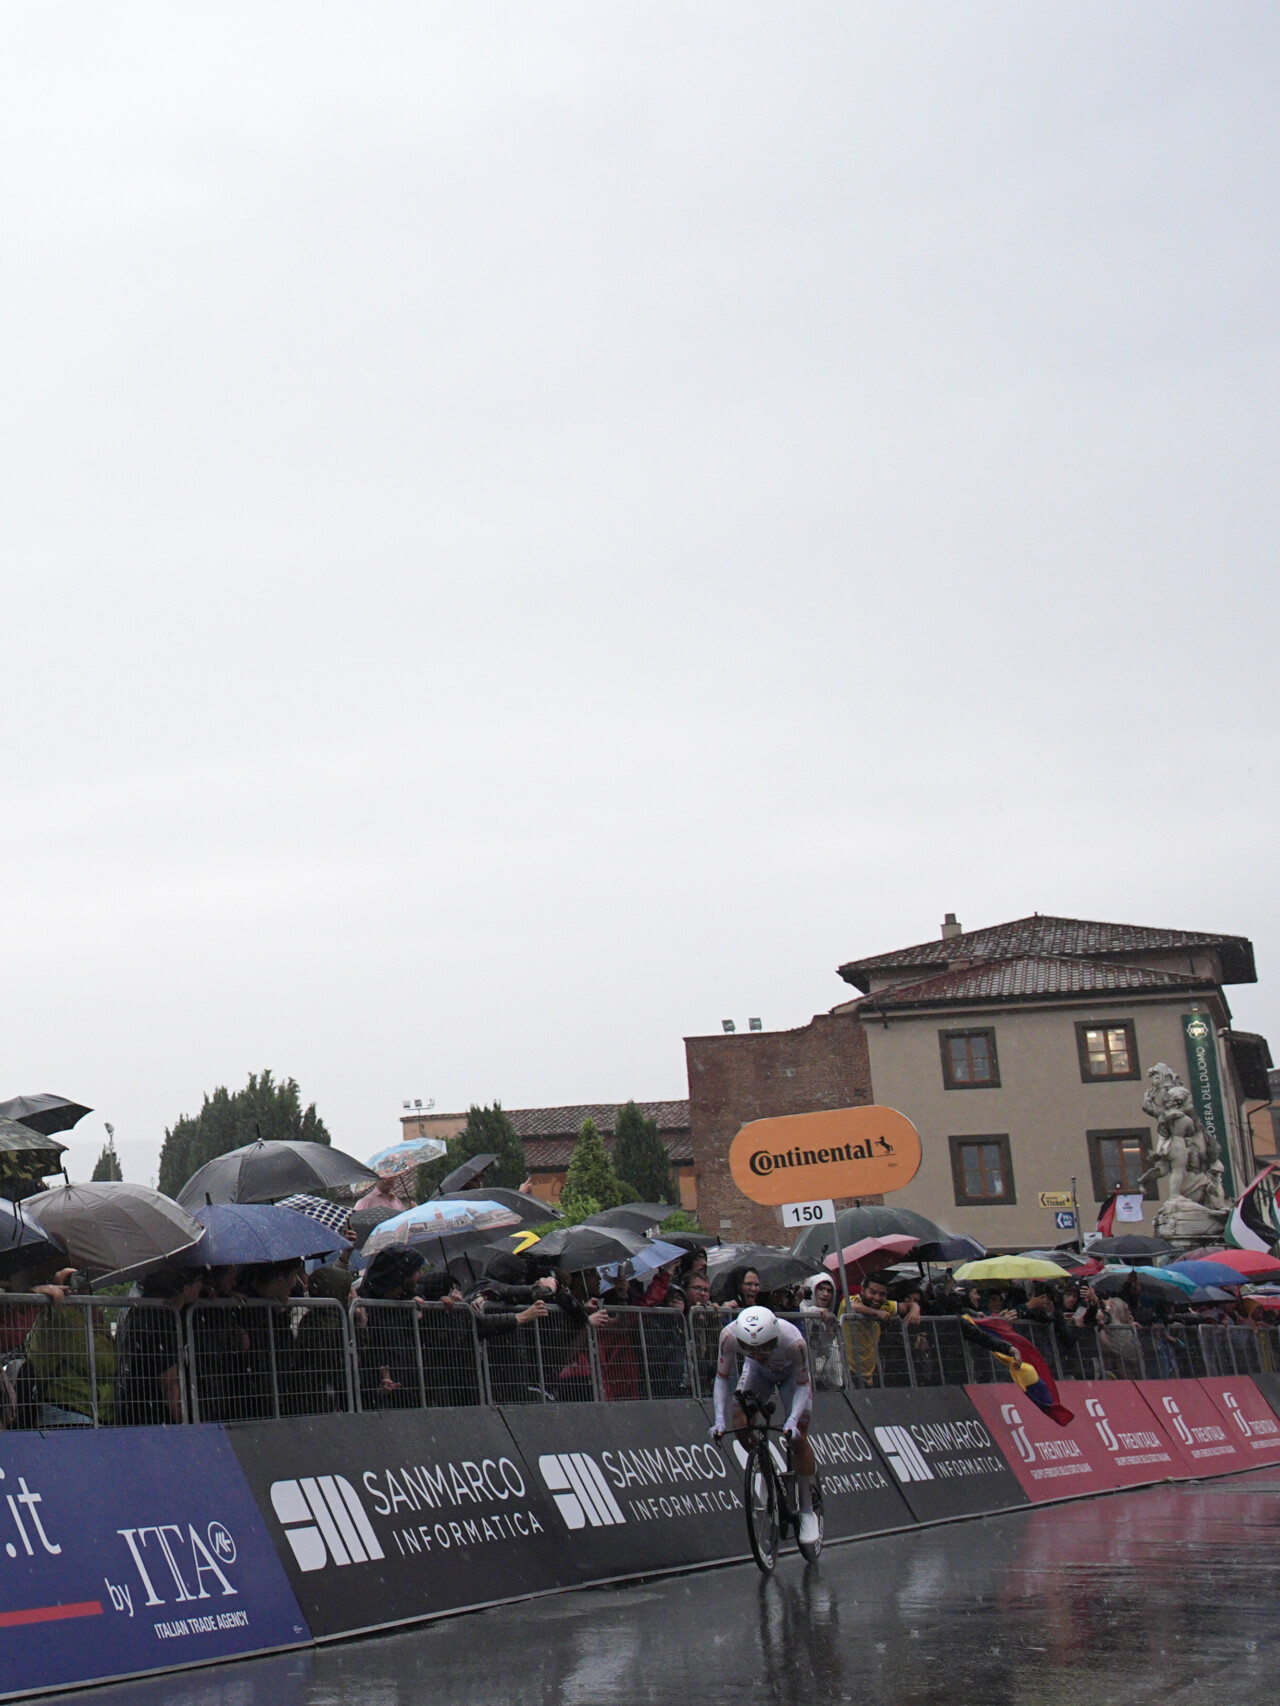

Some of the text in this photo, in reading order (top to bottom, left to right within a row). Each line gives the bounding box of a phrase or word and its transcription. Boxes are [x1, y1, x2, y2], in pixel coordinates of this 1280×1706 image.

[1196, 1046, 1210, 1082] DUOMO
[1201, 1082, 1211, 1101] DEL
[749, 1138, 874, 1176] Continental
[792, 1205, 823, 1222] 150
[910, 1420, 991, 1453] SANMARCO
[1117, 1431, 1162, 1450] TRENITALIA
[1190, 1425, 1227, 1444] TRENITALIA
[1034, 1439, 1082, 1461] TRENITALIA
[601, 1443, 727, 1488] SANMARCO
[933, 1456, 1006, 1479] INFORMATICA
[362, 1456, 526, 1516] SANMARCO
[821, 1471, 888, 1495] FORMATICA
[629, 1489, 744, 1521] INFORMATICA
[392, 1510, 545, 1556] INFORMATICA
[104, 1523, 238, 1617] by ITA
[154, 1610, 250, 1639] ITALIAN TRADE AGENCY
